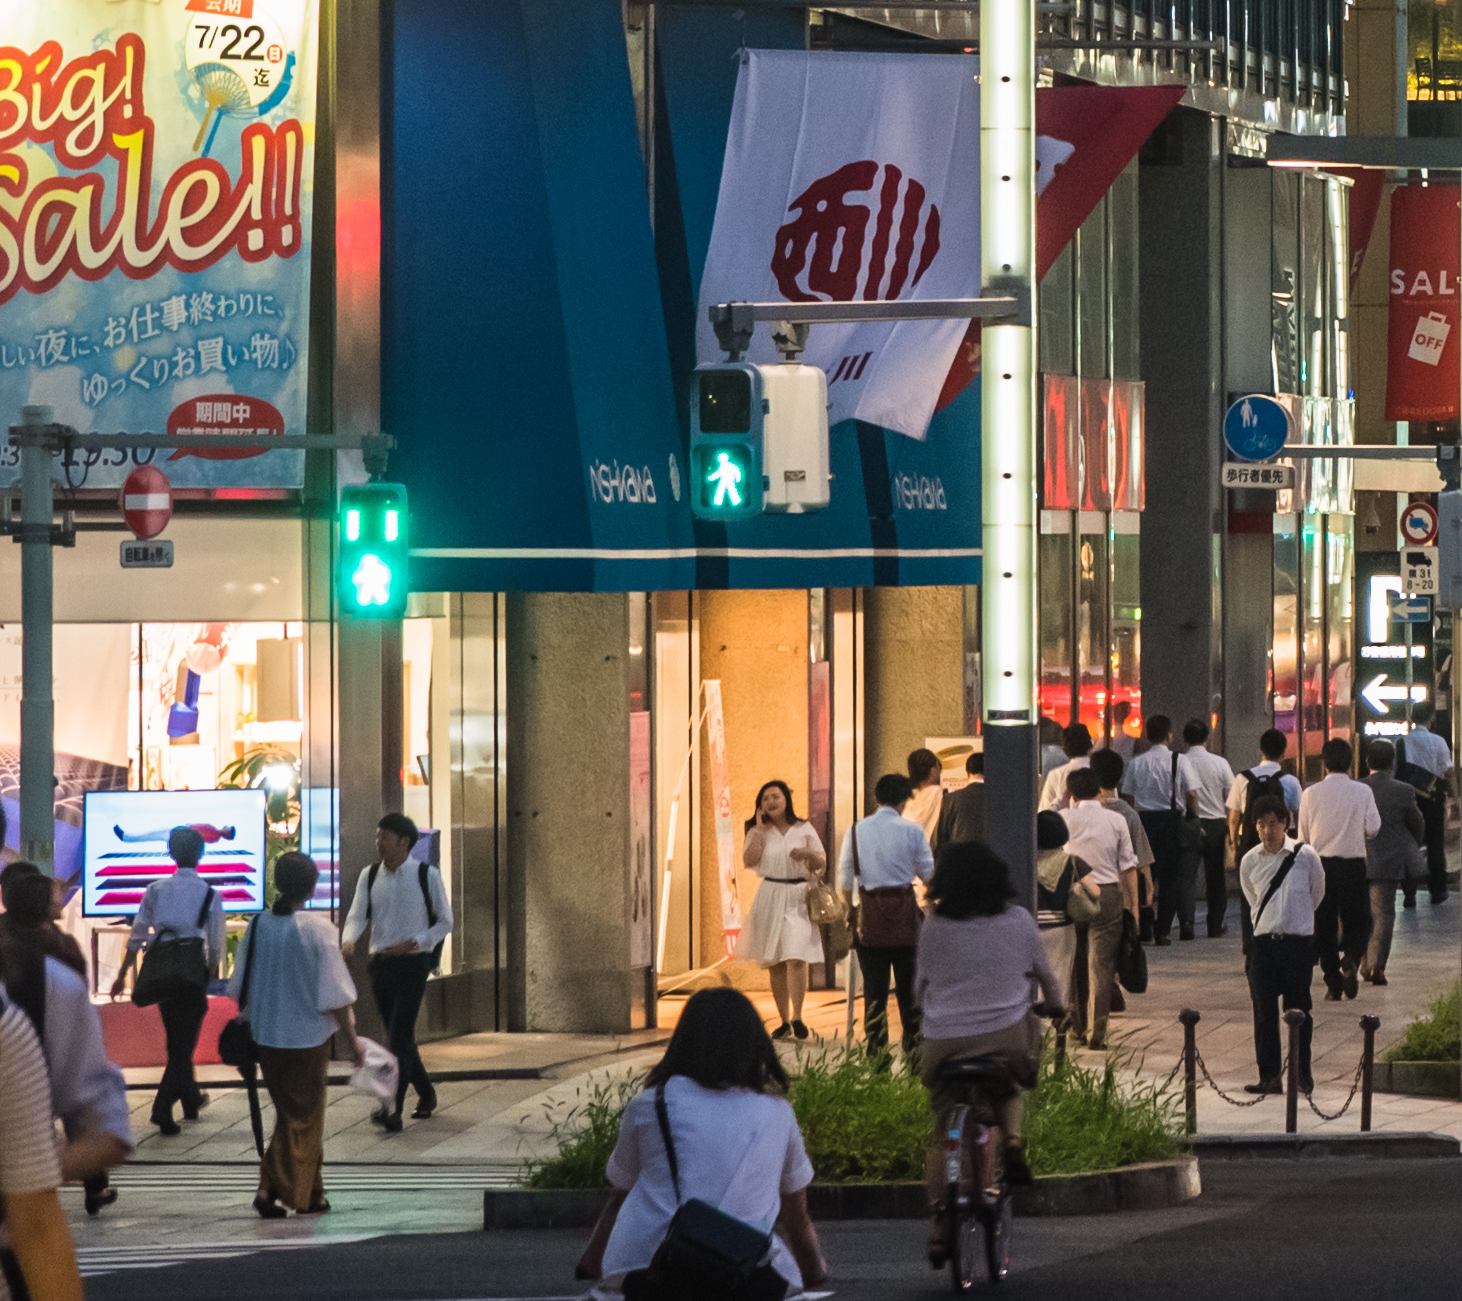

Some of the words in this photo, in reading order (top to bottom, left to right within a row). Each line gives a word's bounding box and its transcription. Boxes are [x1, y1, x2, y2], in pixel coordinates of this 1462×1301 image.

[194, 24, 265, 61] 7/22
[253, 68, 270, 88] 迄
[1391, 269, 1455, 296] SAL
[1414, 333, 1444, 350] OFF
[195, 402, 251, 424] 期間中
[1225, 467, 1285, 485] 歩行者優先
